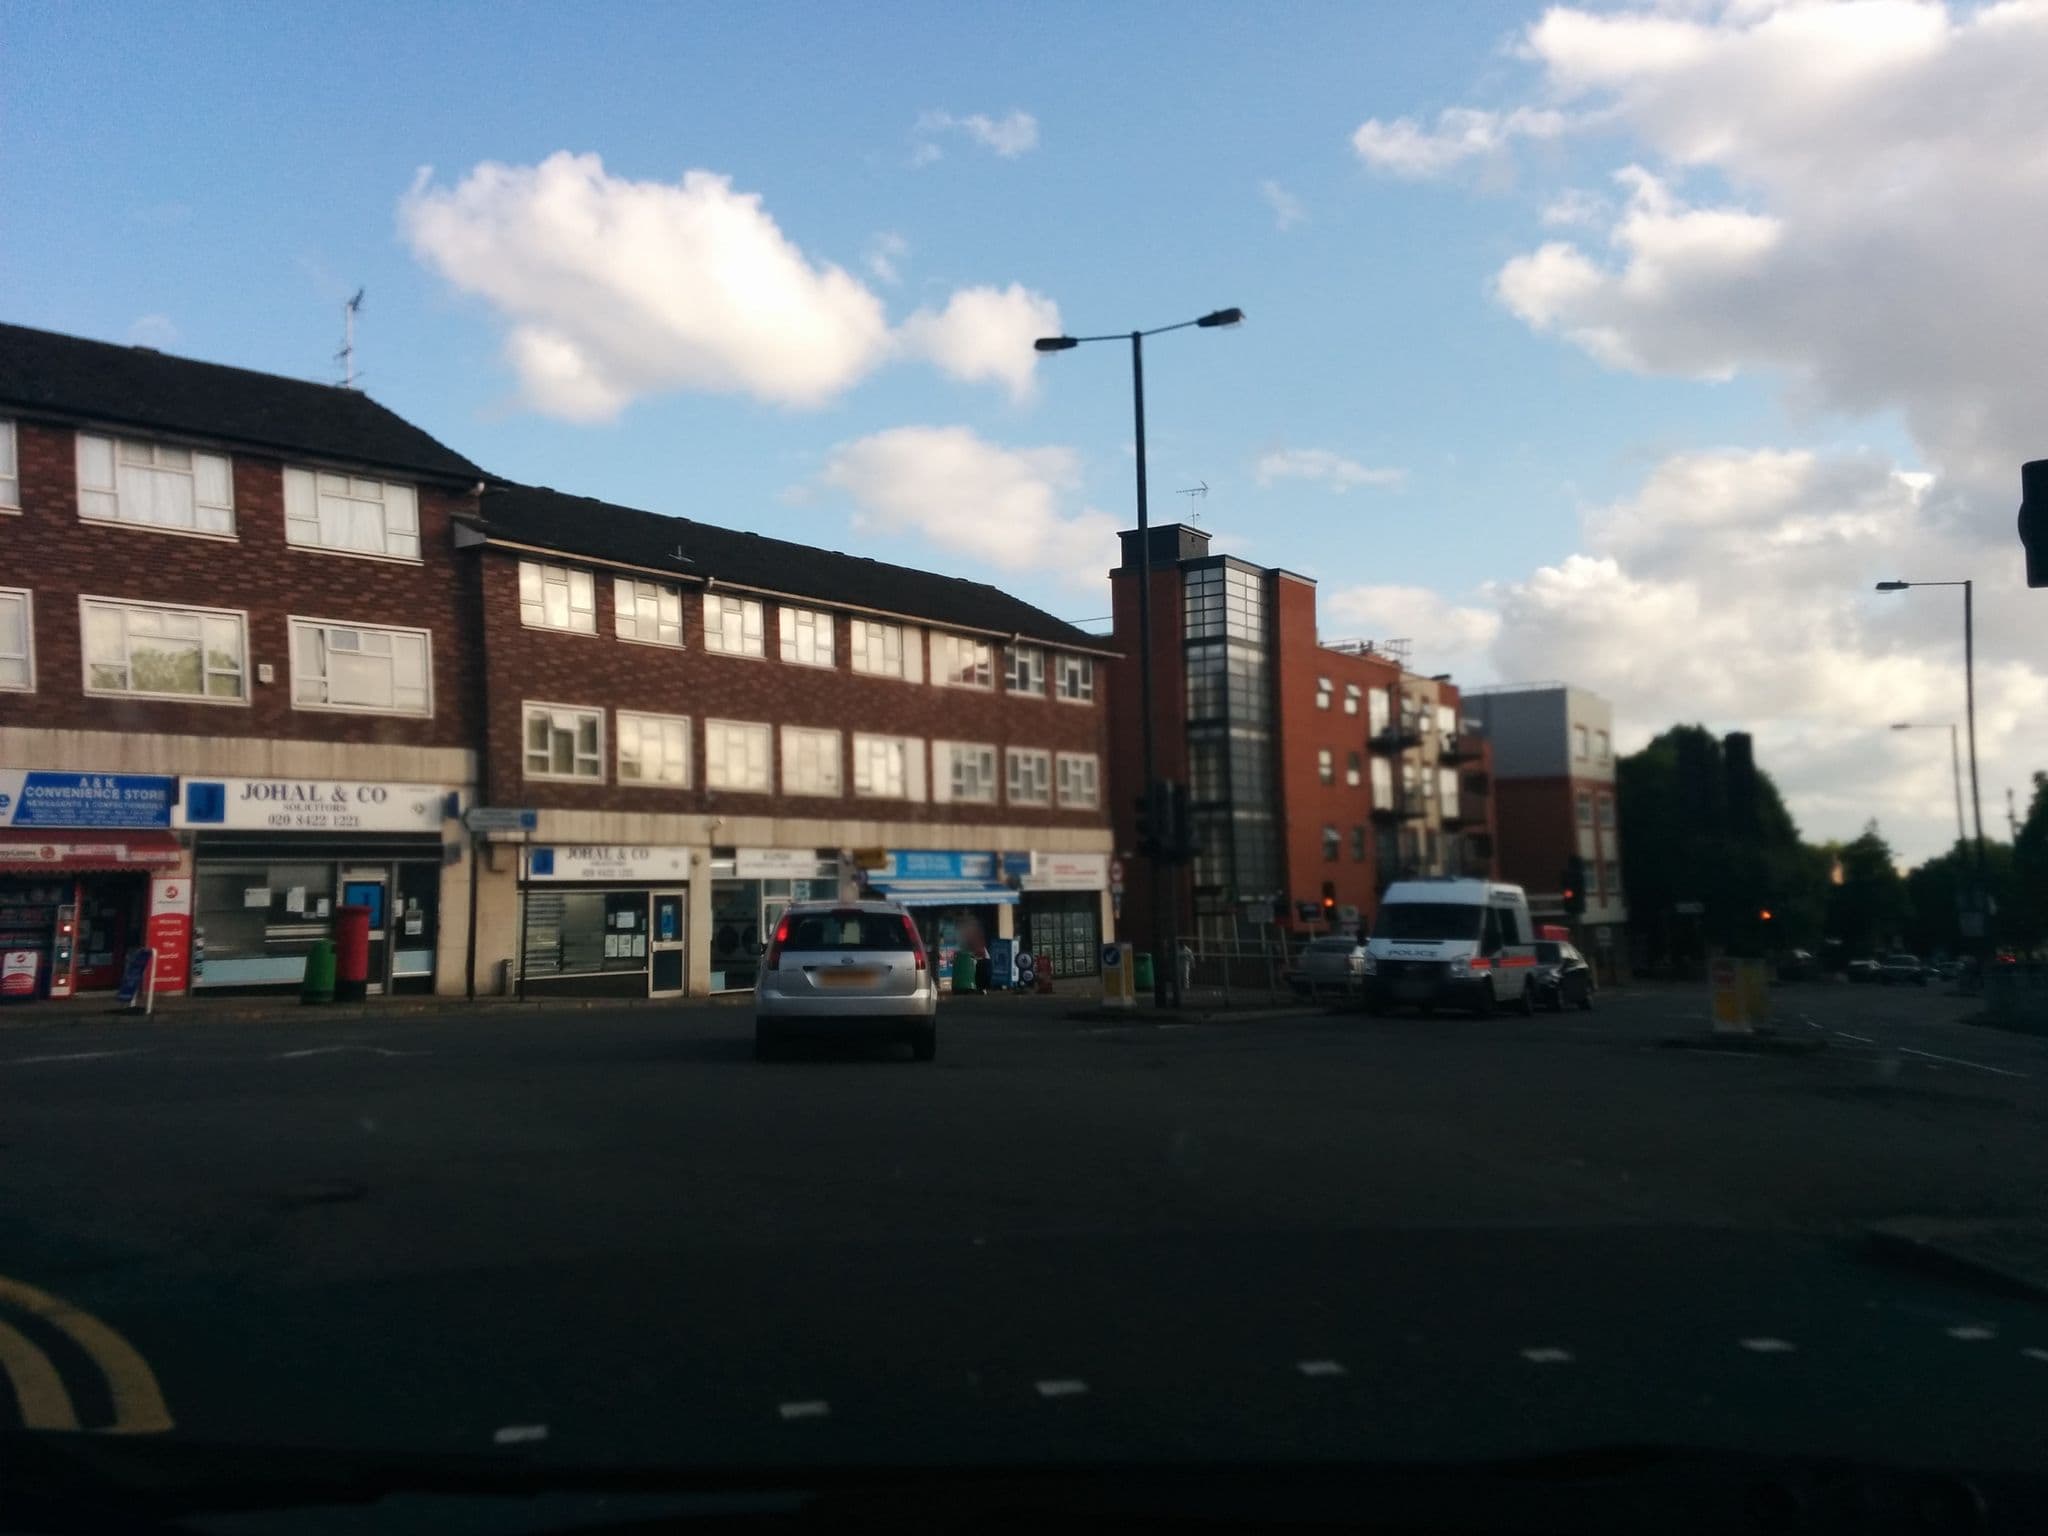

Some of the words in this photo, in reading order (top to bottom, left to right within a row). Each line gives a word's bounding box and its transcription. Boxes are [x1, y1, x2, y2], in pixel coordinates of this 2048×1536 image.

[80, 777, 89, 787] A
[93, 778, 101, 788] &
[25, 786, 120, 800] CONVENIENCE
[124, 789, 166, 800] STORE
[240, 783, 322, 802] JOHAL
[331, 785, 348, 802] &
[356, 787, 387, 804] CO
[283, 803, 347, 812] SOLICITORS
[267, 814, 291, 824] 020
[296, 815, 327, 826] 8422
[332, 815, 360, 827] 1221
[567, 847, 612, 860] JOHAL
[616, 848, 626, 861] &
[631, 848, 649, 860] CO
